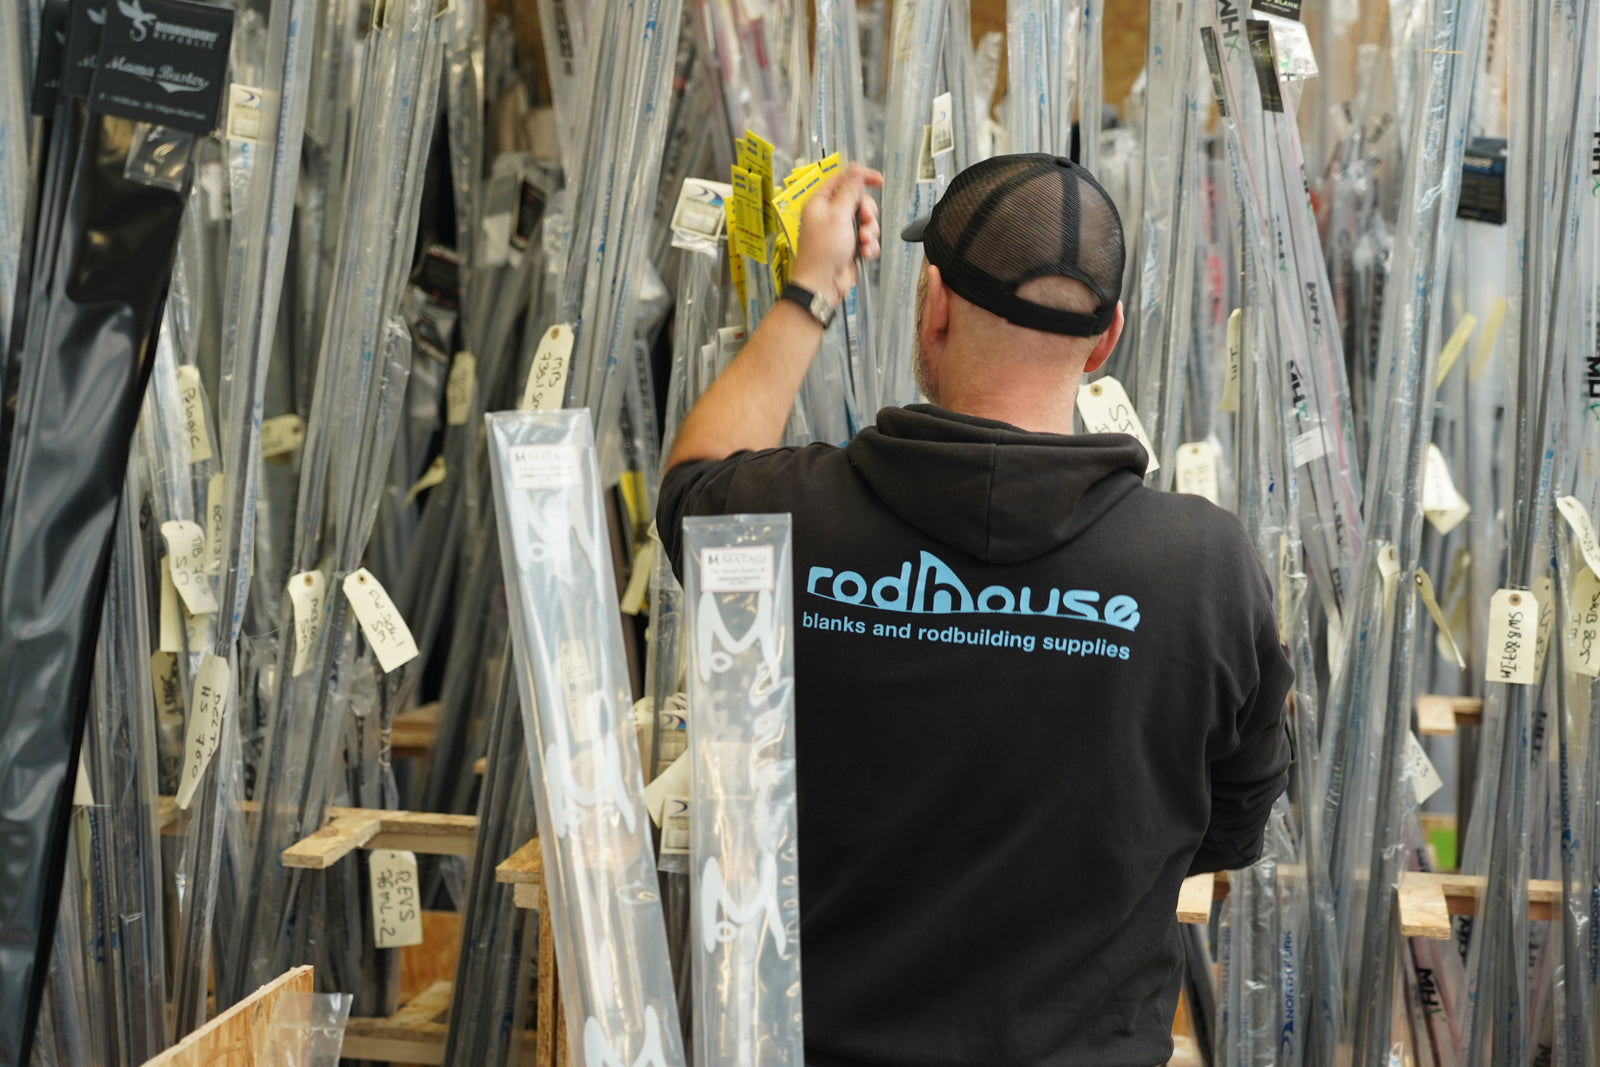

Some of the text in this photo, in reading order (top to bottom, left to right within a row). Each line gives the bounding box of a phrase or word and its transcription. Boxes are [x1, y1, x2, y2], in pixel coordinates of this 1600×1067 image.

[807, 550, 1140, 632] rodhouse
[802, 611, 1130, 661] blanks and rodbuilding supplies
[394, 869, 416, 923] REVS
